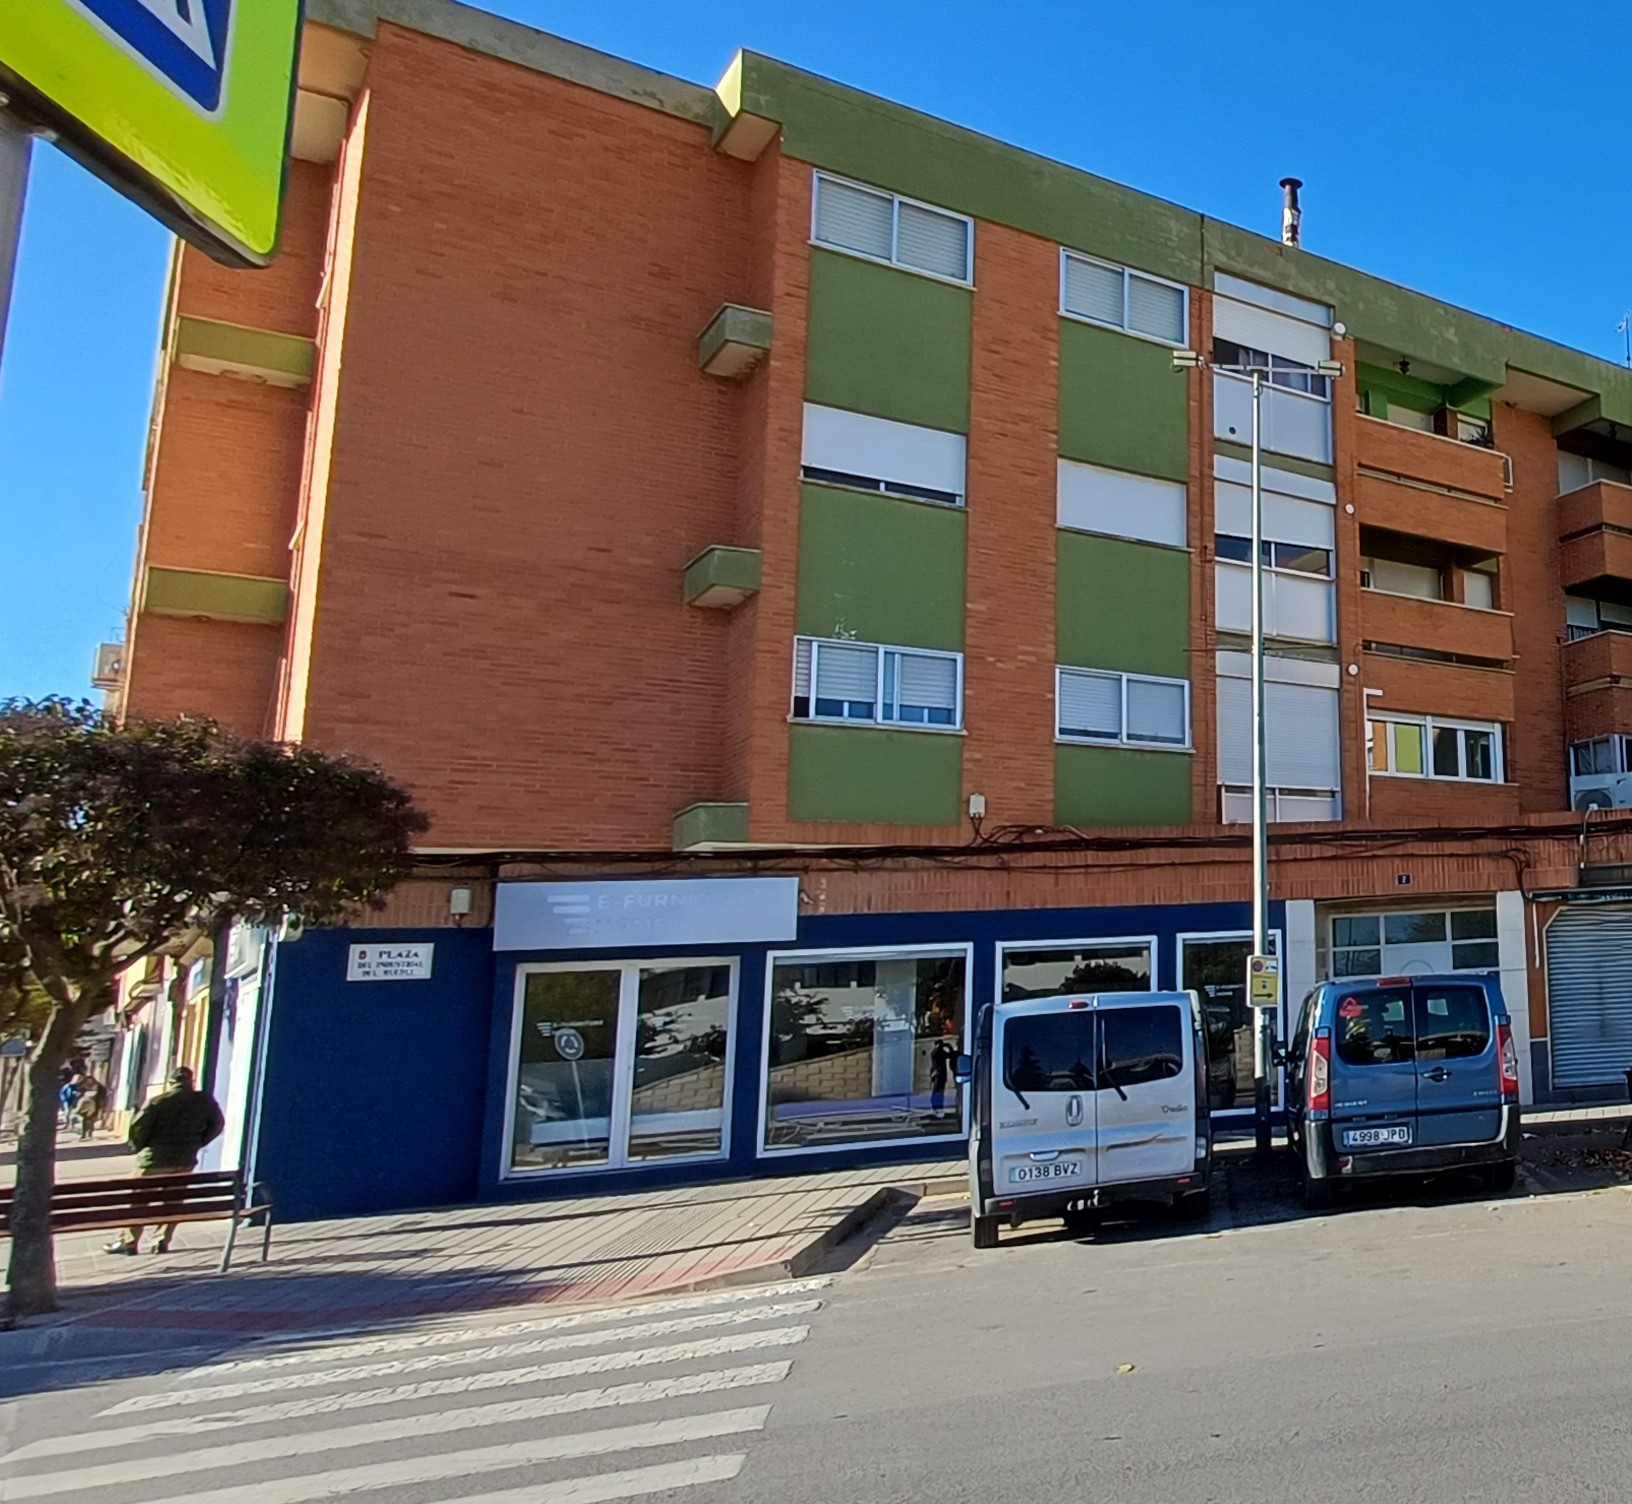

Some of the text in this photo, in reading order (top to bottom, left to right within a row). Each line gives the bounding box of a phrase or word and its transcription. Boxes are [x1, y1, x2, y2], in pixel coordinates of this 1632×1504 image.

[379, 949, 419, 959] PLAZA
[1352, 1131, 1380, 1142] 4998
[1018, 1163, 1078, 1180] 0138 BVZ
